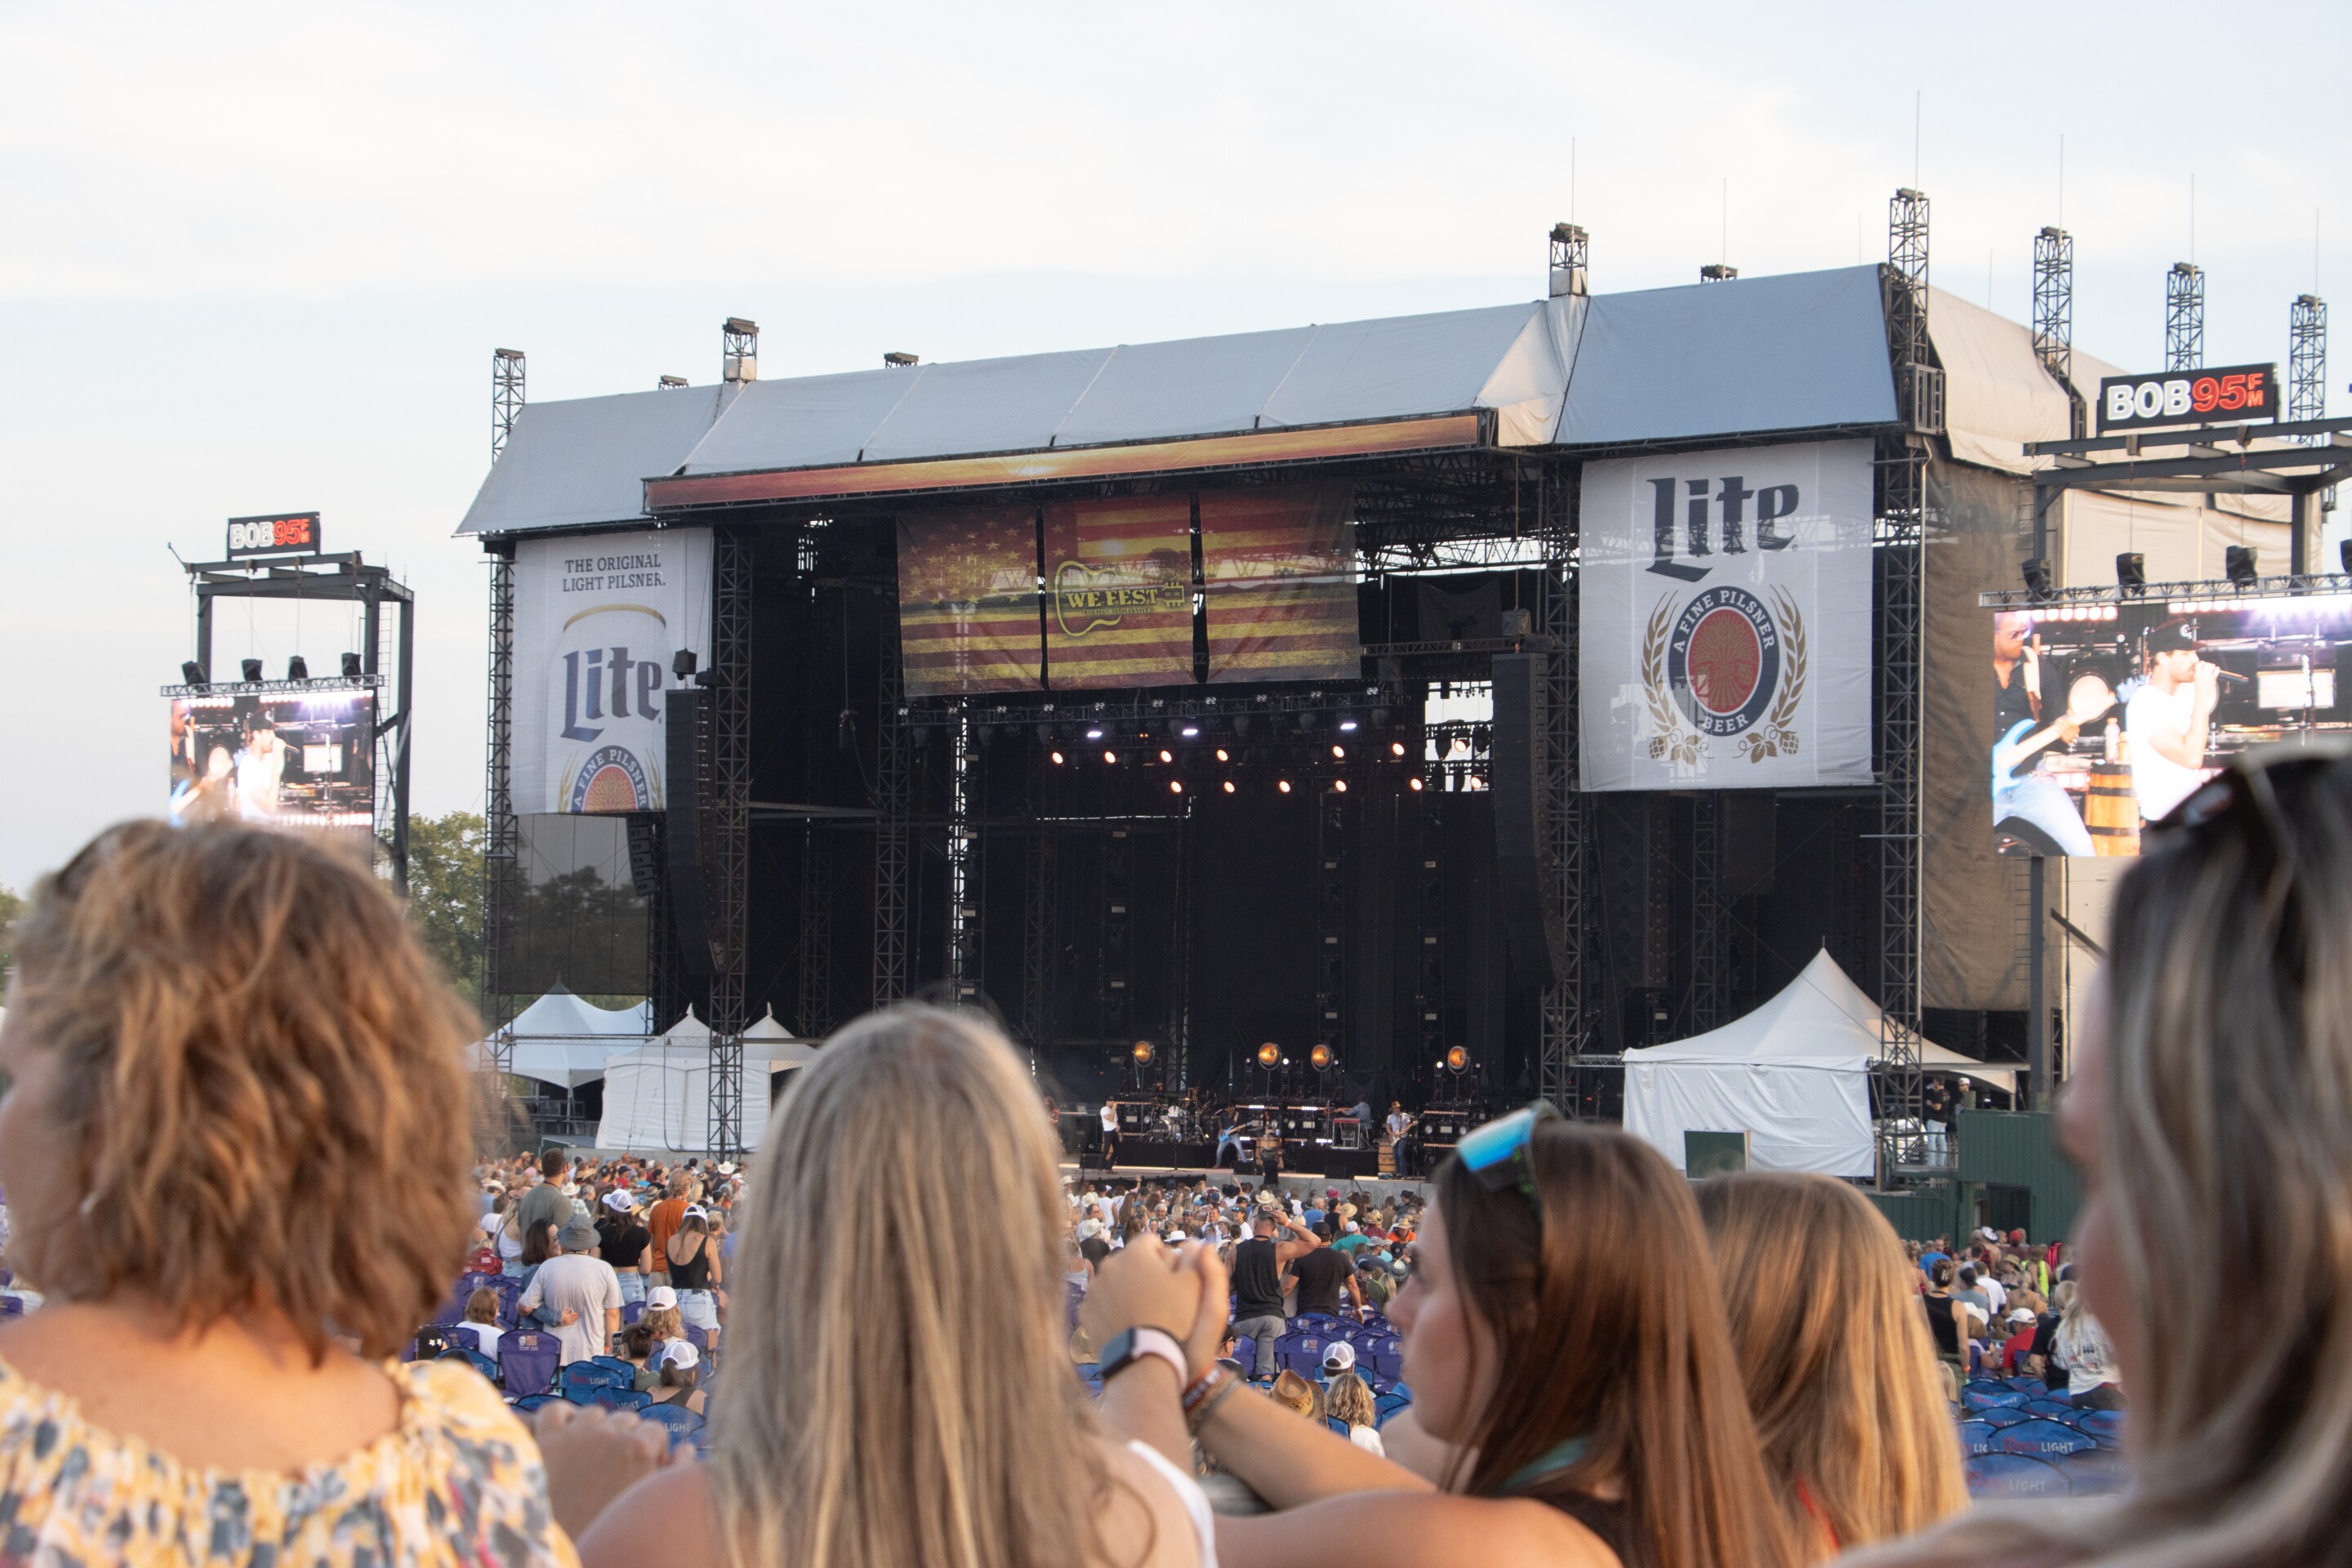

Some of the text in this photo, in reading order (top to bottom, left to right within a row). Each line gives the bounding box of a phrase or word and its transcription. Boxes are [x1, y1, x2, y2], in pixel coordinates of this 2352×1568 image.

[1645, 476, 1800, 582] Lite
[565, 554, 661, 573] THE ORIGINAL
[563, 572, 666, 592] LIGHT PILSNER.
[1066, 589, 1158, 608] WE FEST
[1082, 608, 1107, 616] COUNTRY
[1126, 606, 1155, 614] FESTIVAL
[1673, 590, 1776, 653] A FINE PILSNER
[560, 647, 662, 743] Lite
[1703, 713, 1749, 733] BEER
[573, 749, 648, 808] A FINE PILSNER
[589, 1377, 610, 1385] LIGHT
[1974, 1443, 1989, 1453] LIG
[2041, 1441, 2074, 1453] LIGHT
